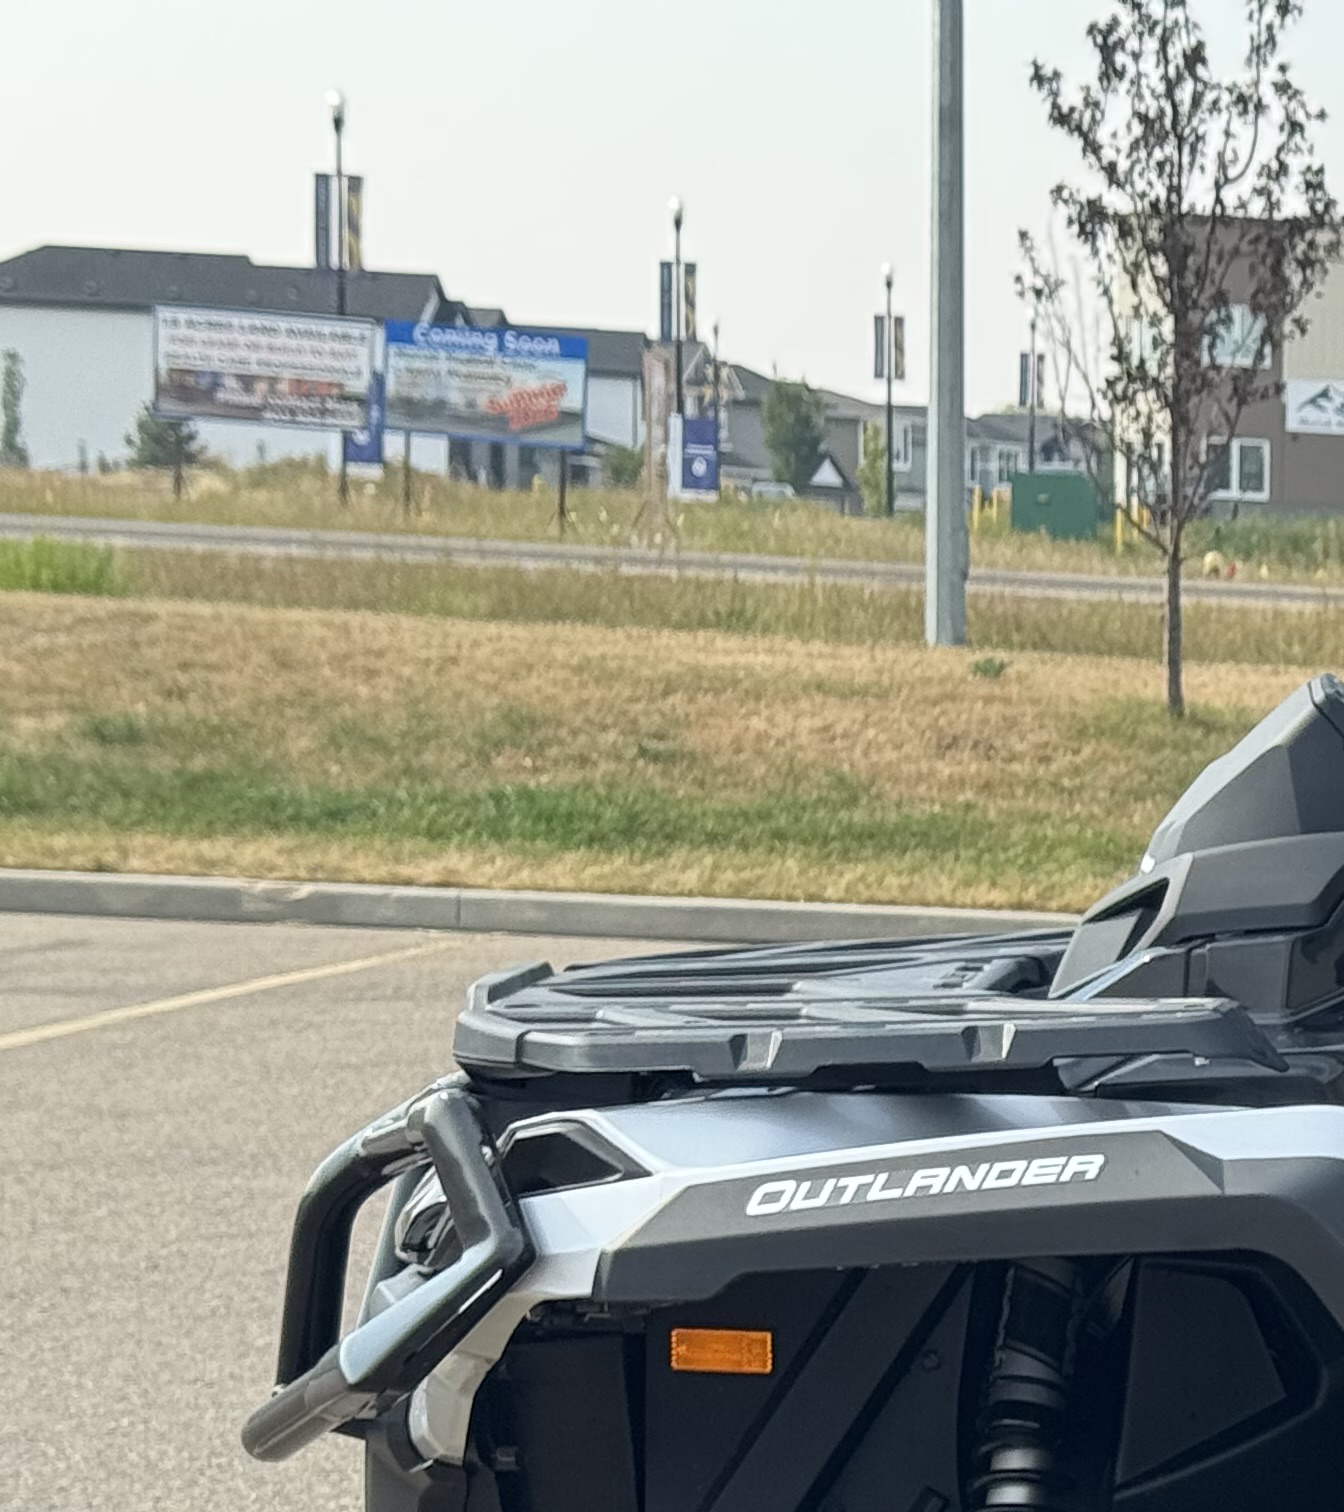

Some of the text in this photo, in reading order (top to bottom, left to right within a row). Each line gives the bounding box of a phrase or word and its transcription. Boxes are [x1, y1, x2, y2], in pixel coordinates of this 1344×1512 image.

[413, 321, 561, 355] Coming Soon
[745, 1154, 1105, 1216] OUTLANDER
